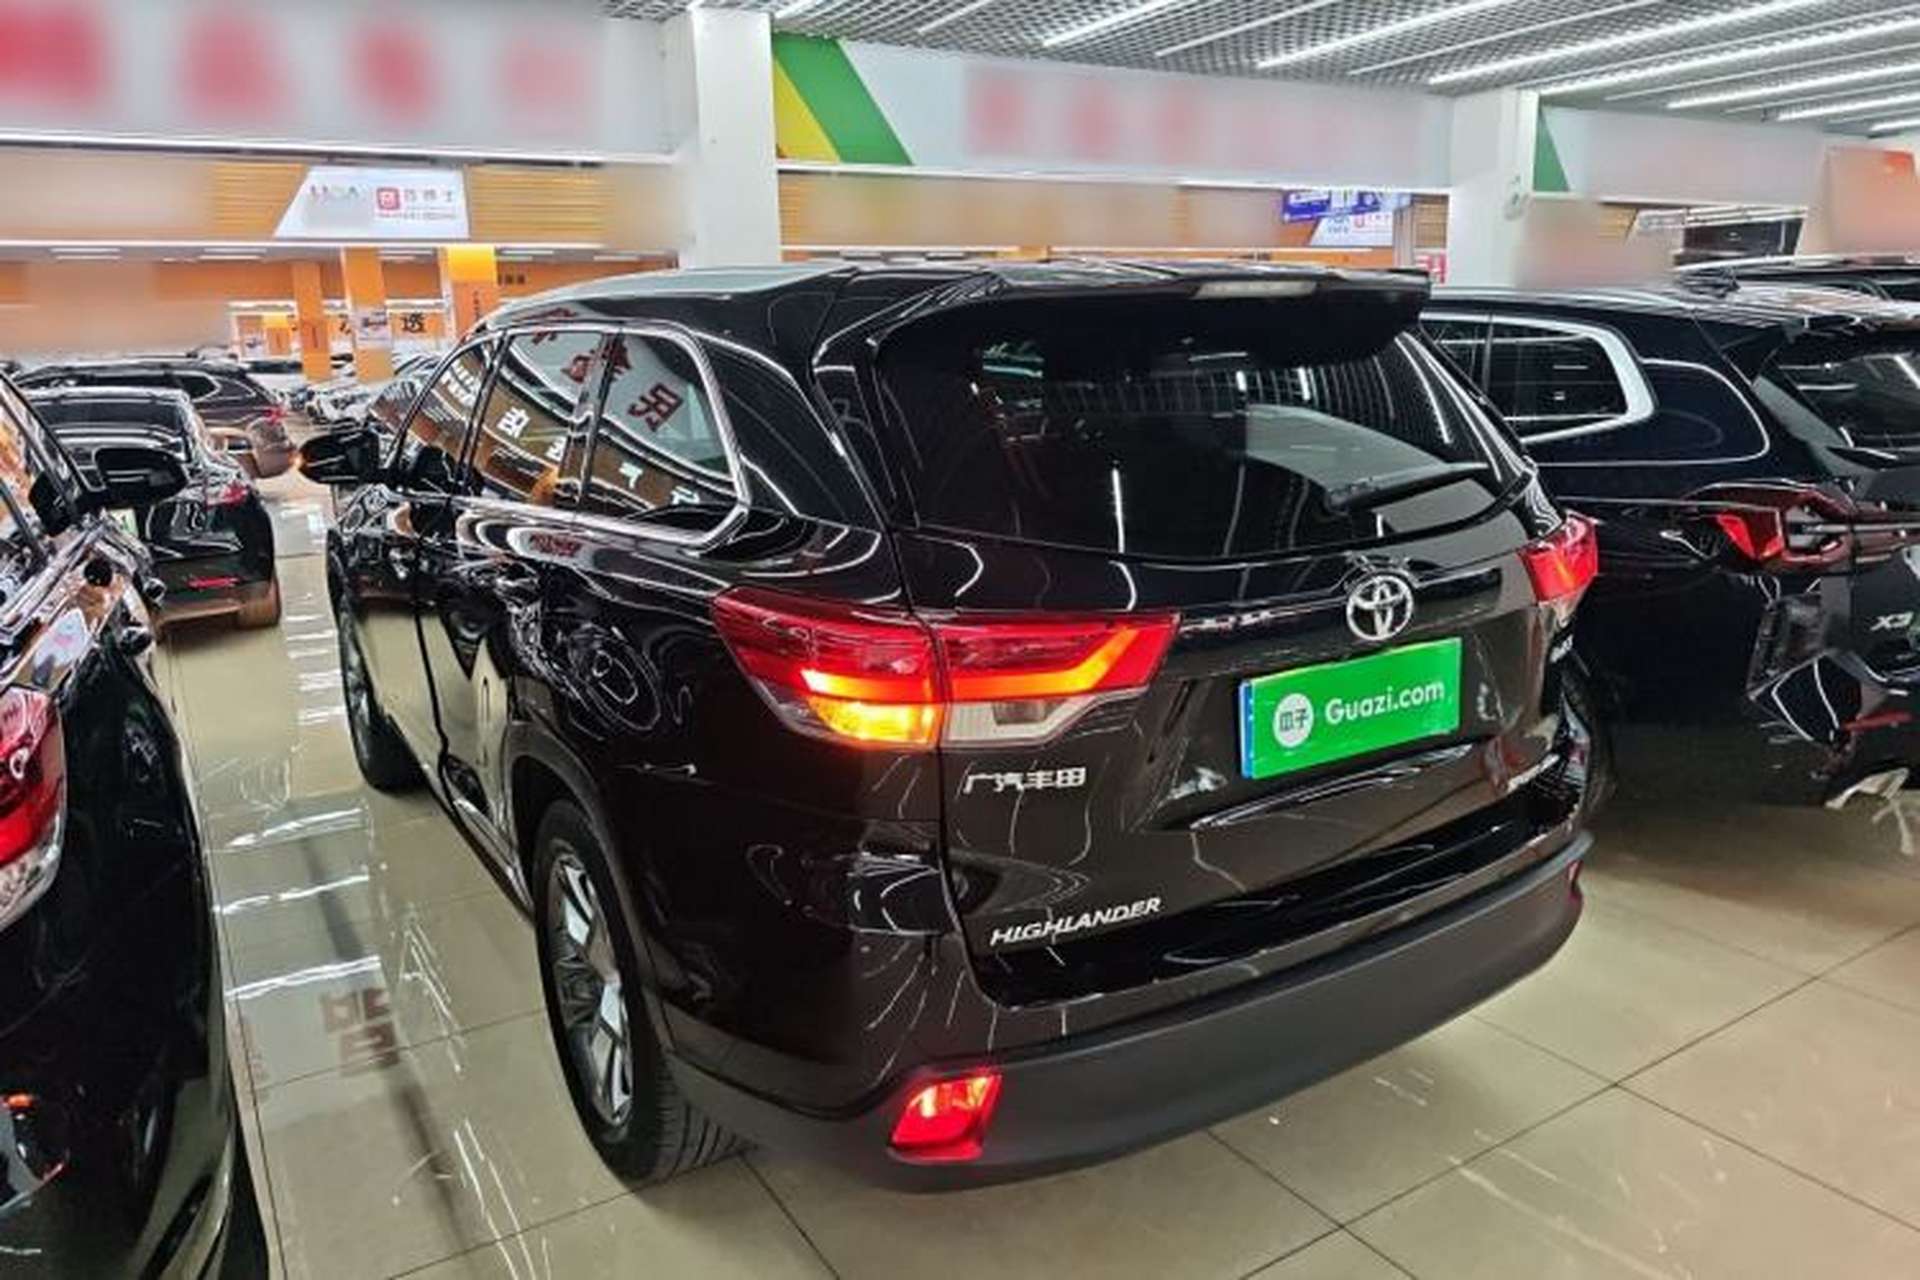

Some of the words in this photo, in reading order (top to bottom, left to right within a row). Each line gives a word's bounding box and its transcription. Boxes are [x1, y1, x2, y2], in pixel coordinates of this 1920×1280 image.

[1324, 680, 1446, 725] Guazi.com
[962, 766, 1087, 795] 广汽丰田
[989, 896, 1162, 947] HIGHLANDER
